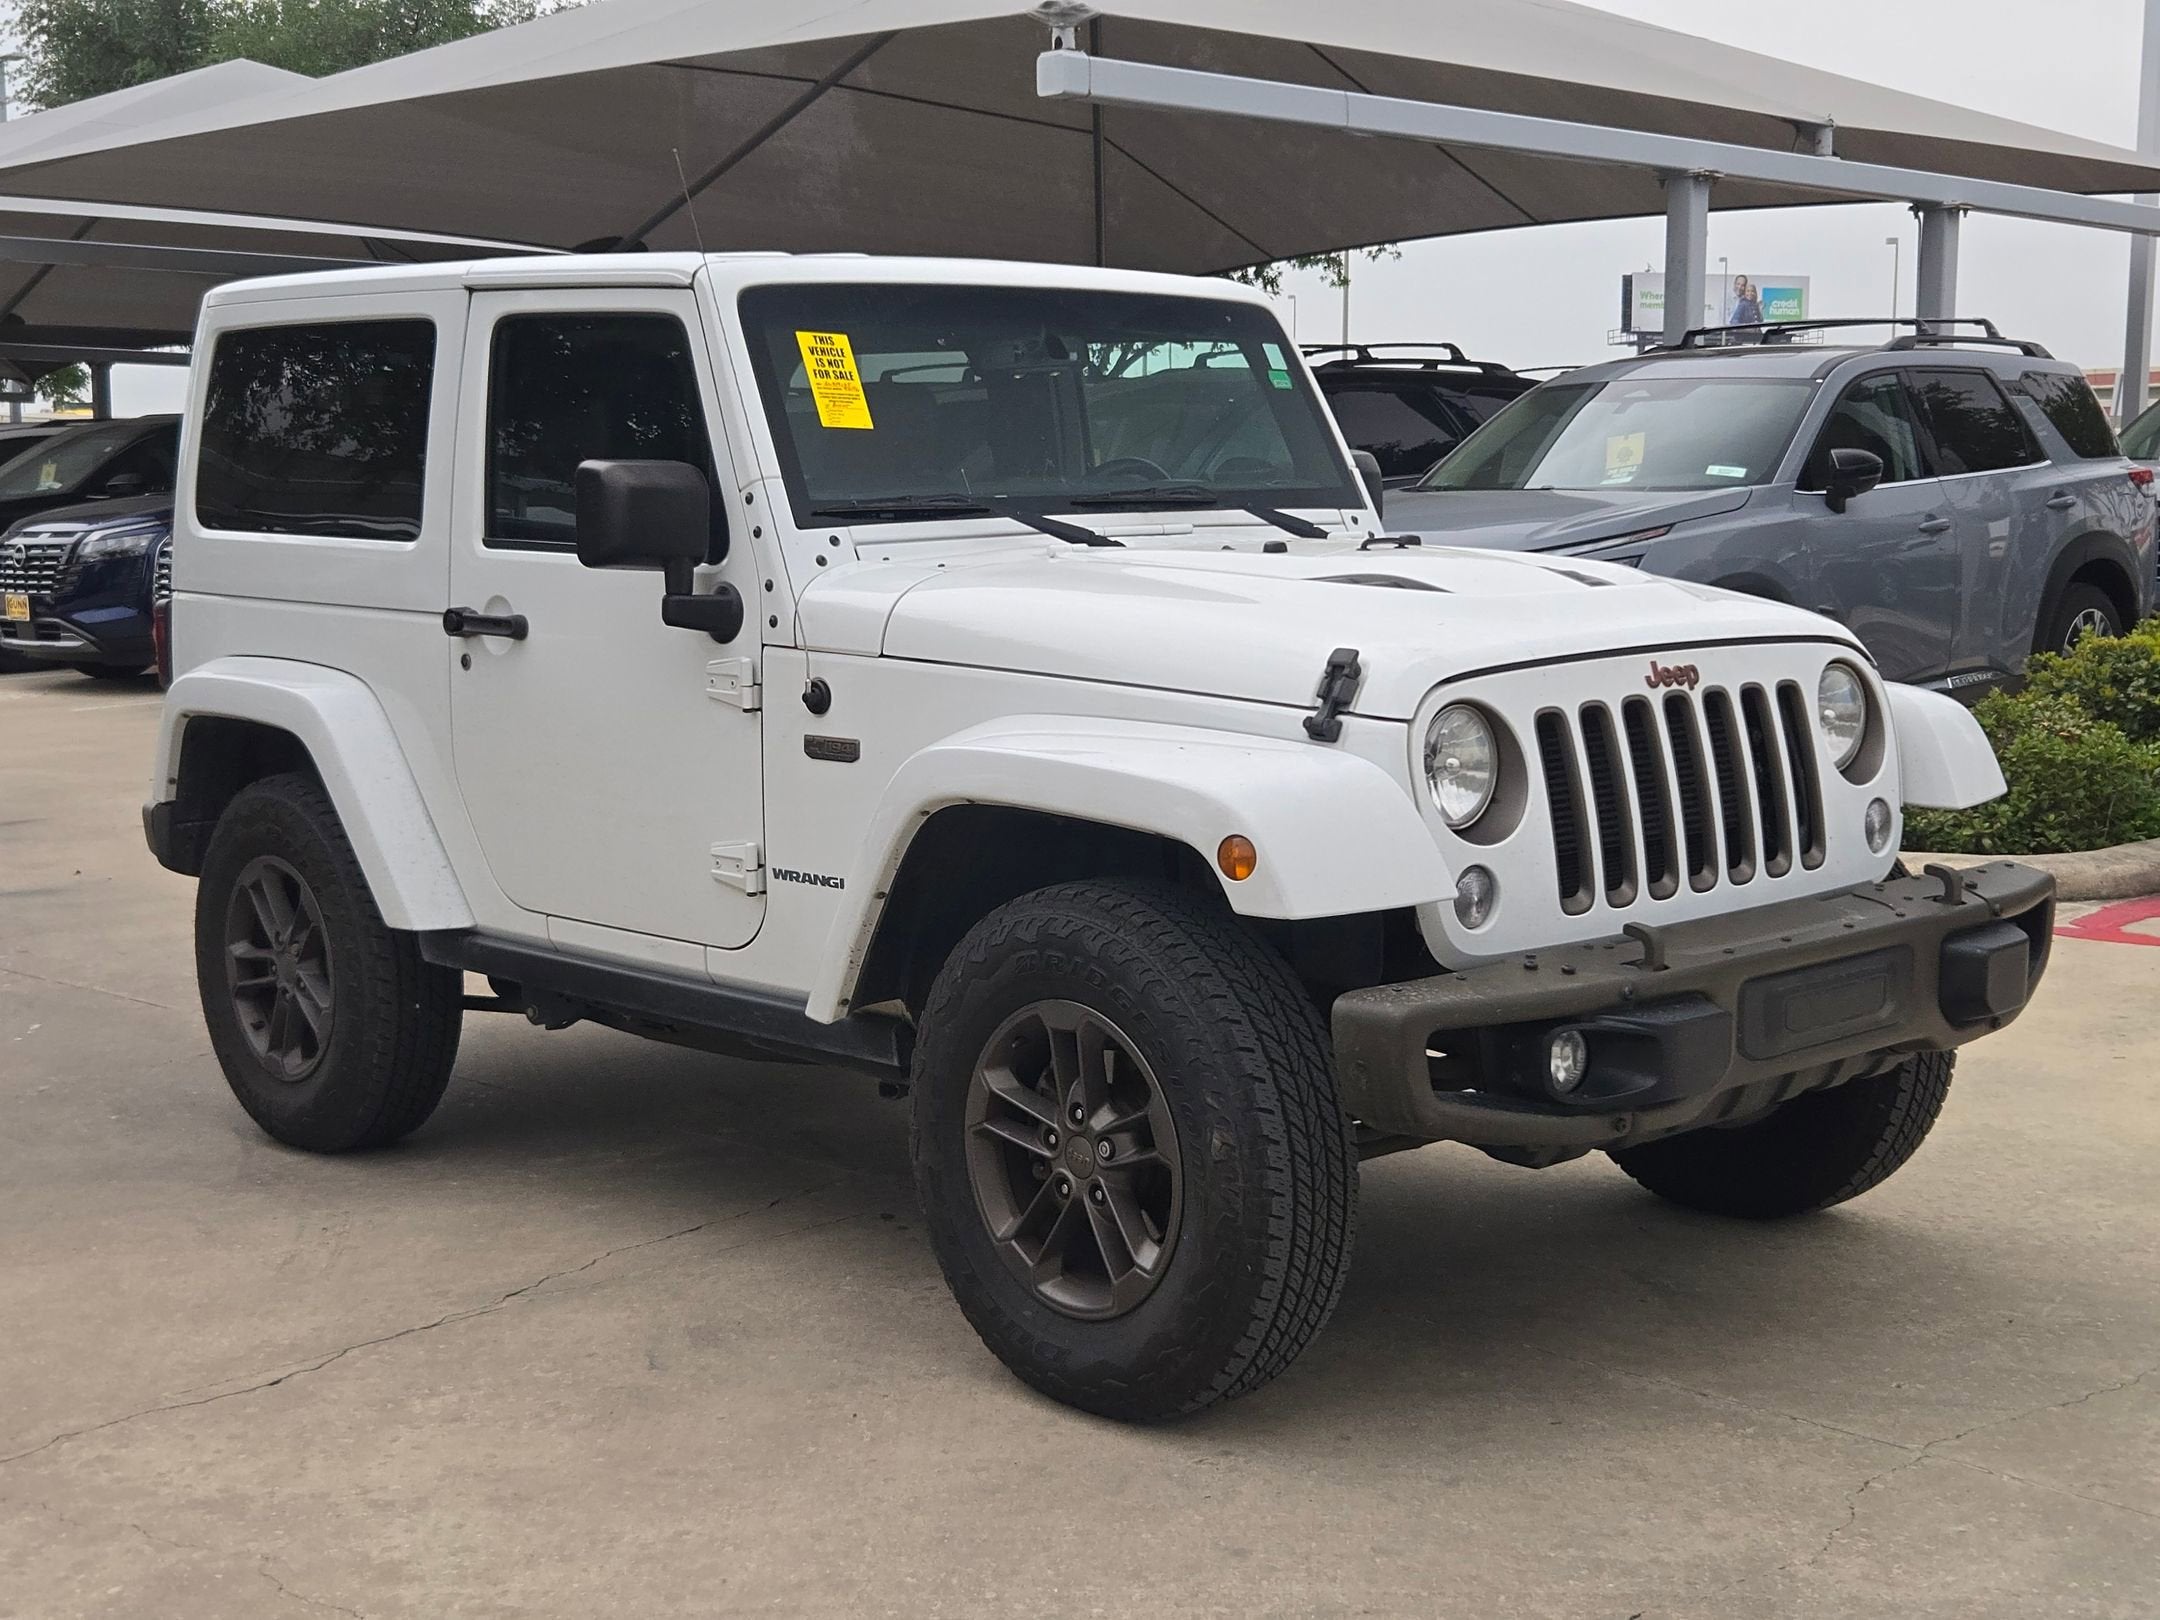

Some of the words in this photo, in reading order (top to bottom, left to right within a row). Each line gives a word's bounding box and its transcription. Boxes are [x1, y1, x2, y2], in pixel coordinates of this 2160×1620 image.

[1771, 299, 1798, 308] credit
[1769, 307, 1800, 316] human
[813, 335, 835, 346] THIS
[808, 346, 846, 358] VEHICLE
[815, 358, 826, 368] IS
[827, 358, 845, 369] NOT
[813, 369, 831, 379] FOR
[832, 370, 854, 381] SALE
[1644, 660, 1700, 691] Jeep
